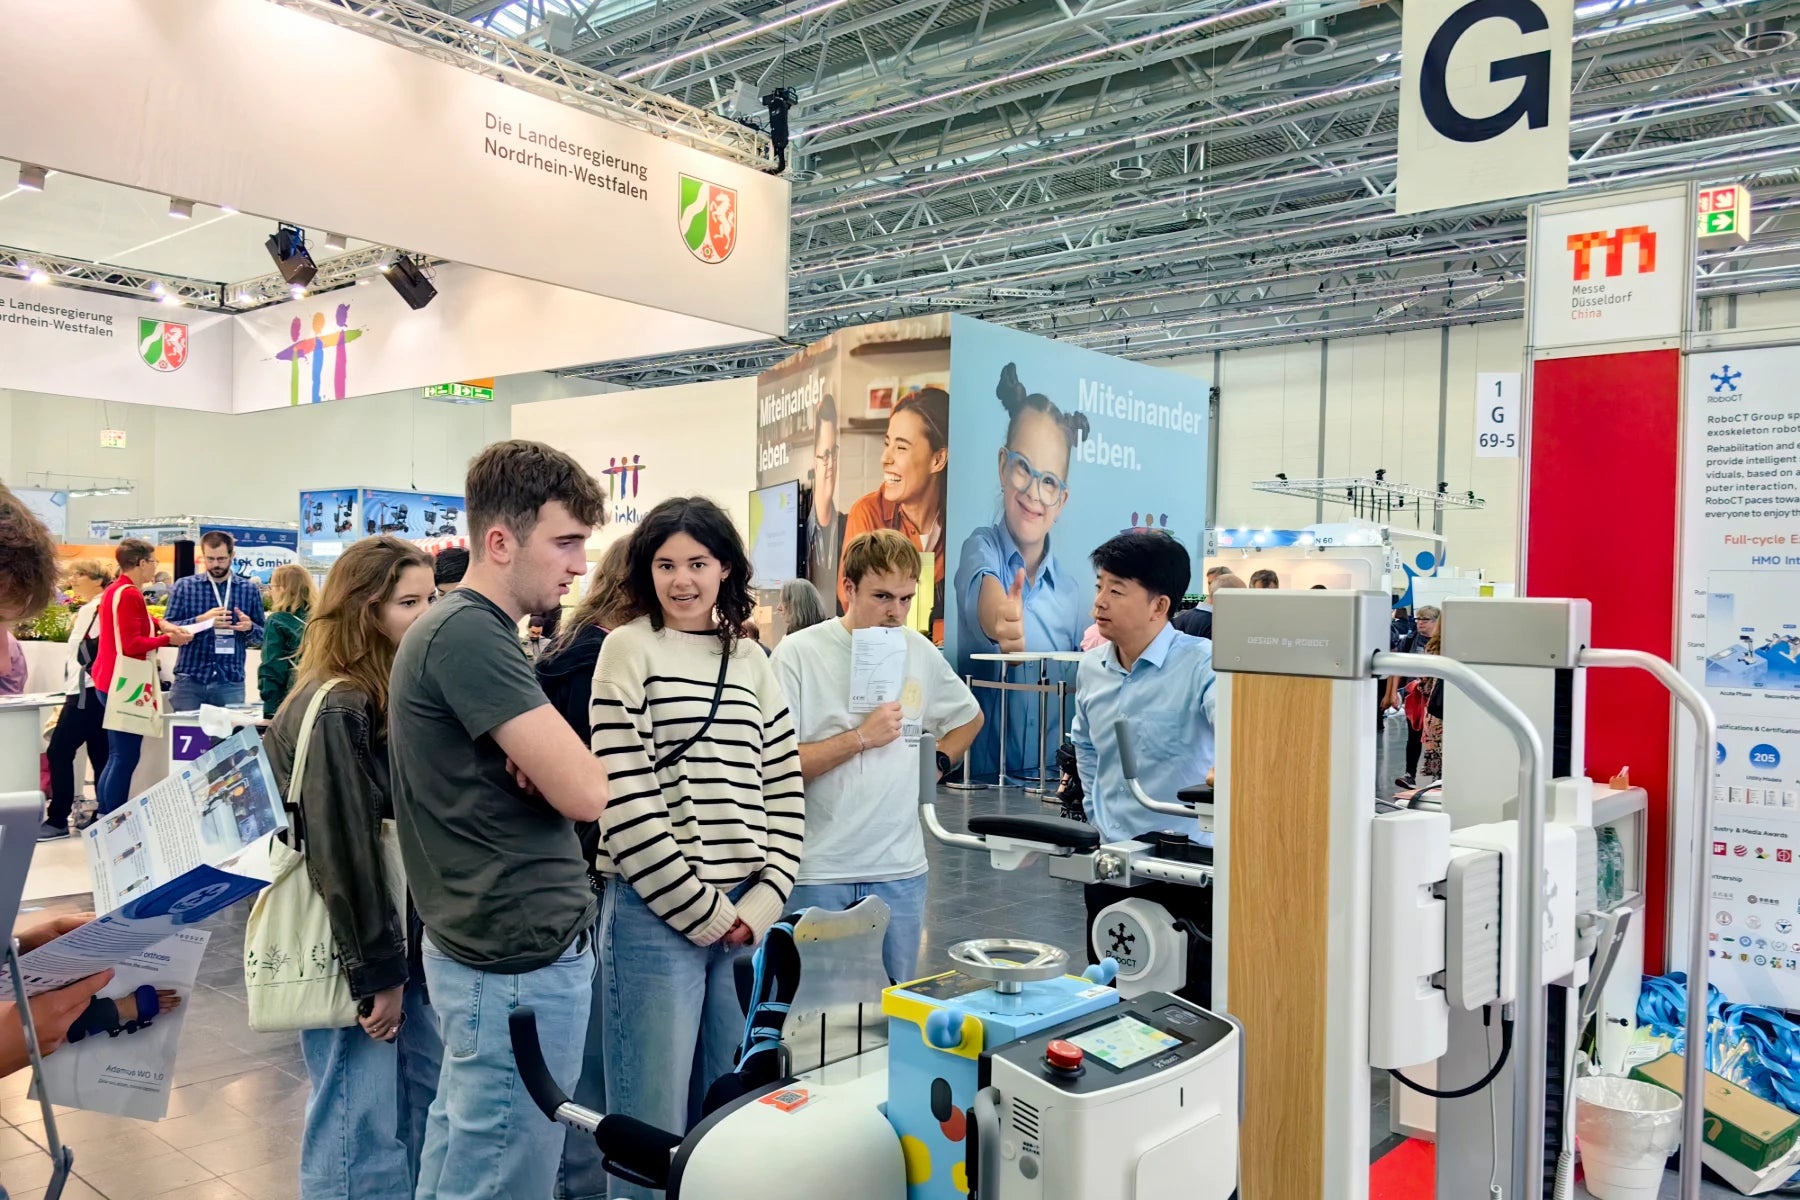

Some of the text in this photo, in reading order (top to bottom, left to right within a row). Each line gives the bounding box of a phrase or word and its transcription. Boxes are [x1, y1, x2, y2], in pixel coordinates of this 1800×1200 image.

[1420, 0, 1551, 143] G
[485, 112, 648, 181] Die Landesregierung
[485, 137, 648, 200] Nordrhein-Westfalen
[1572, 285, 1605, 295] Messe
[1572, 291, 1632, 307] Düsseldorf
[10, 298, 113, 325] Landesregierung
[1571, 309, 1601, 319] China
[0, 313, 113, 337] rdrhein-Westfalen
[1495, 381, 1502, 397] 1
[760, 374, 825, 427] Miteinander
[1707, 394, 1742, 403] RoboCT
[1078, 378, 1202, 434] Miteinander
[1492, 406, 1504, 423] G
[1707, 414, 1749, 423] RoboCT
[1751, 413, 1784, 421] Group
[1707, 427, 1769, 436] exoskeleton
[1479, 433, 1515, 447] 69-5
[1077, 429, 1141, 470] leben.
[1707, 443, 1773, 453] Rehabilitation
[1776, 442, 1794, 450] and
[759, 440, 789, 472] leben.
[1706, 456, 1796, 467] provide intelligent
[1706, 470, 1744, 479] viduals,
[1747, 469, 1777, 478] based
[1706, 484, 1734, 493] puter
[1705, 496, 1743, 505] RoboCT
[1745, 497, 1773, 506] paces
[1705, 511, 1750, 519] everyone
[1764, 509, 1790, 519] enjoy
[1724, 534, 1786, 547] Full-cycle
[233, 557, 291, 567] tek GmbH
[1752, 556, 1781, 565] HMO
[180, 736, 192, 753] 7
[1753, 753, 1776, 763] 205
